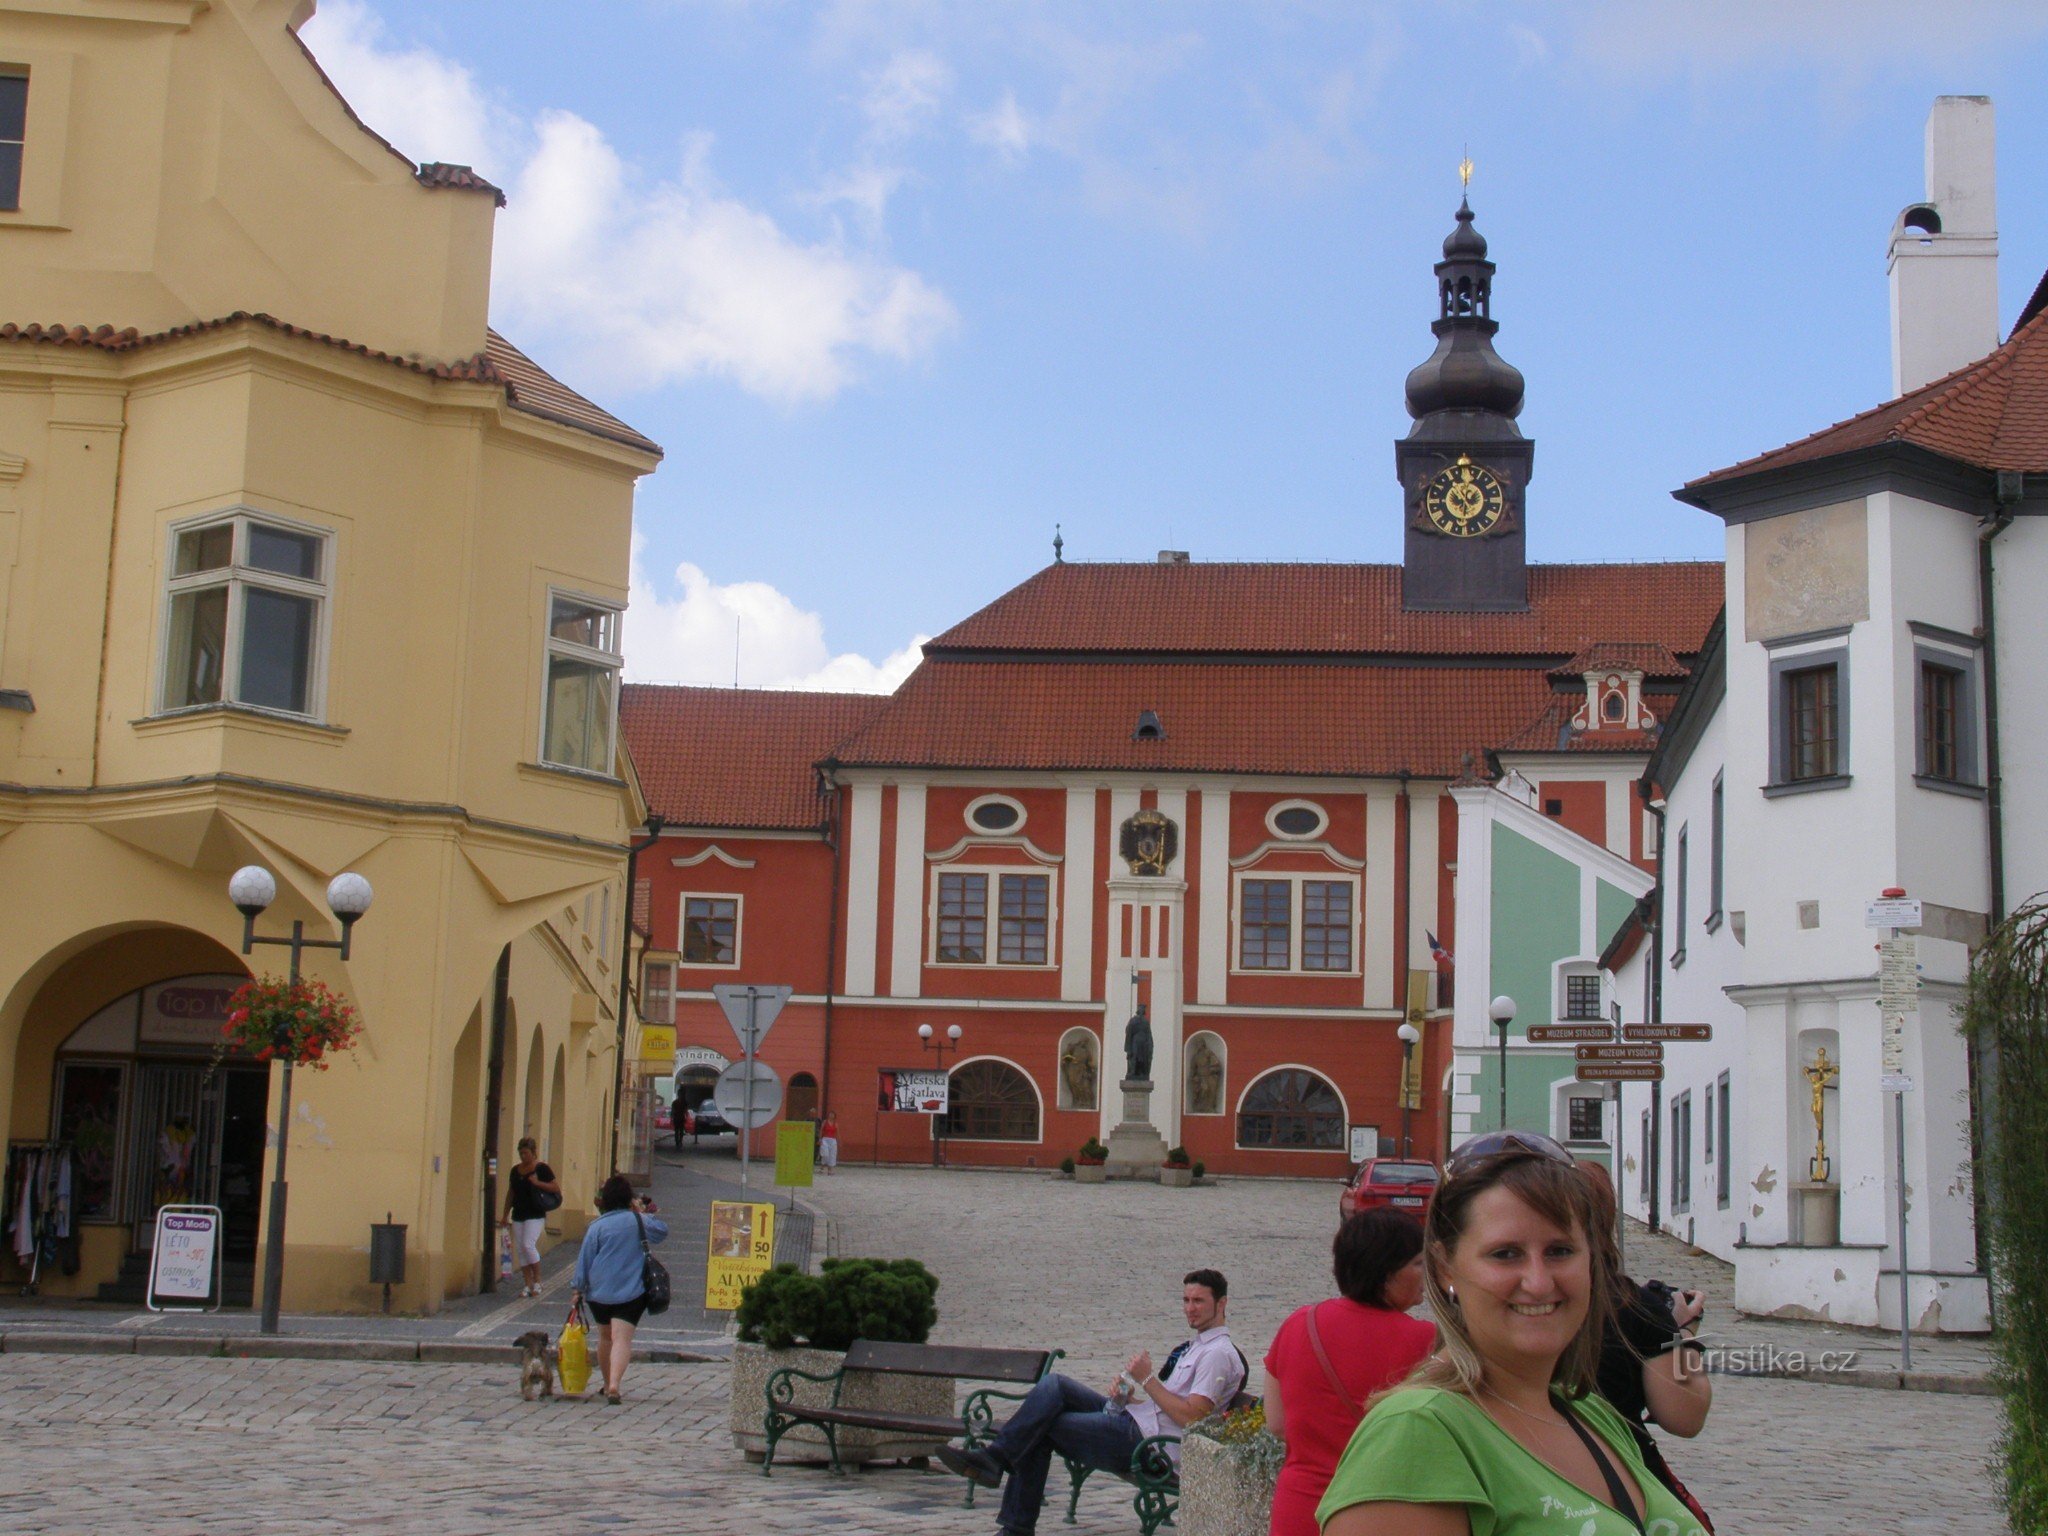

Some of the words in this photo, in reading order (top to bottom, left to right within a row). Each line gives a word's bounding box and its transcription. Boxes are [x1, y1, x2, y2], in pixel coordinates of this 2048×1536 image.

[1546, 1028, 1573, 1038] MUZEUM
[1574, 1027, 1609, 1038] STRAŠIDEL
[1628, 1027, 1668, 1037] VYHLÍDKOVÁ
[1598, 1048, 1625, 1057] MUZEUM
[1626, 1047, 1659, 1057] VYSOČINY
[167, 1218, 184, 1229] Top
[185, 1218, 210, 1229] Mode
[754, 1242, 770, 1253] 50
[718, 1298, 728, 1307] So
[1564, 1502, 1600, 1520] Annual
